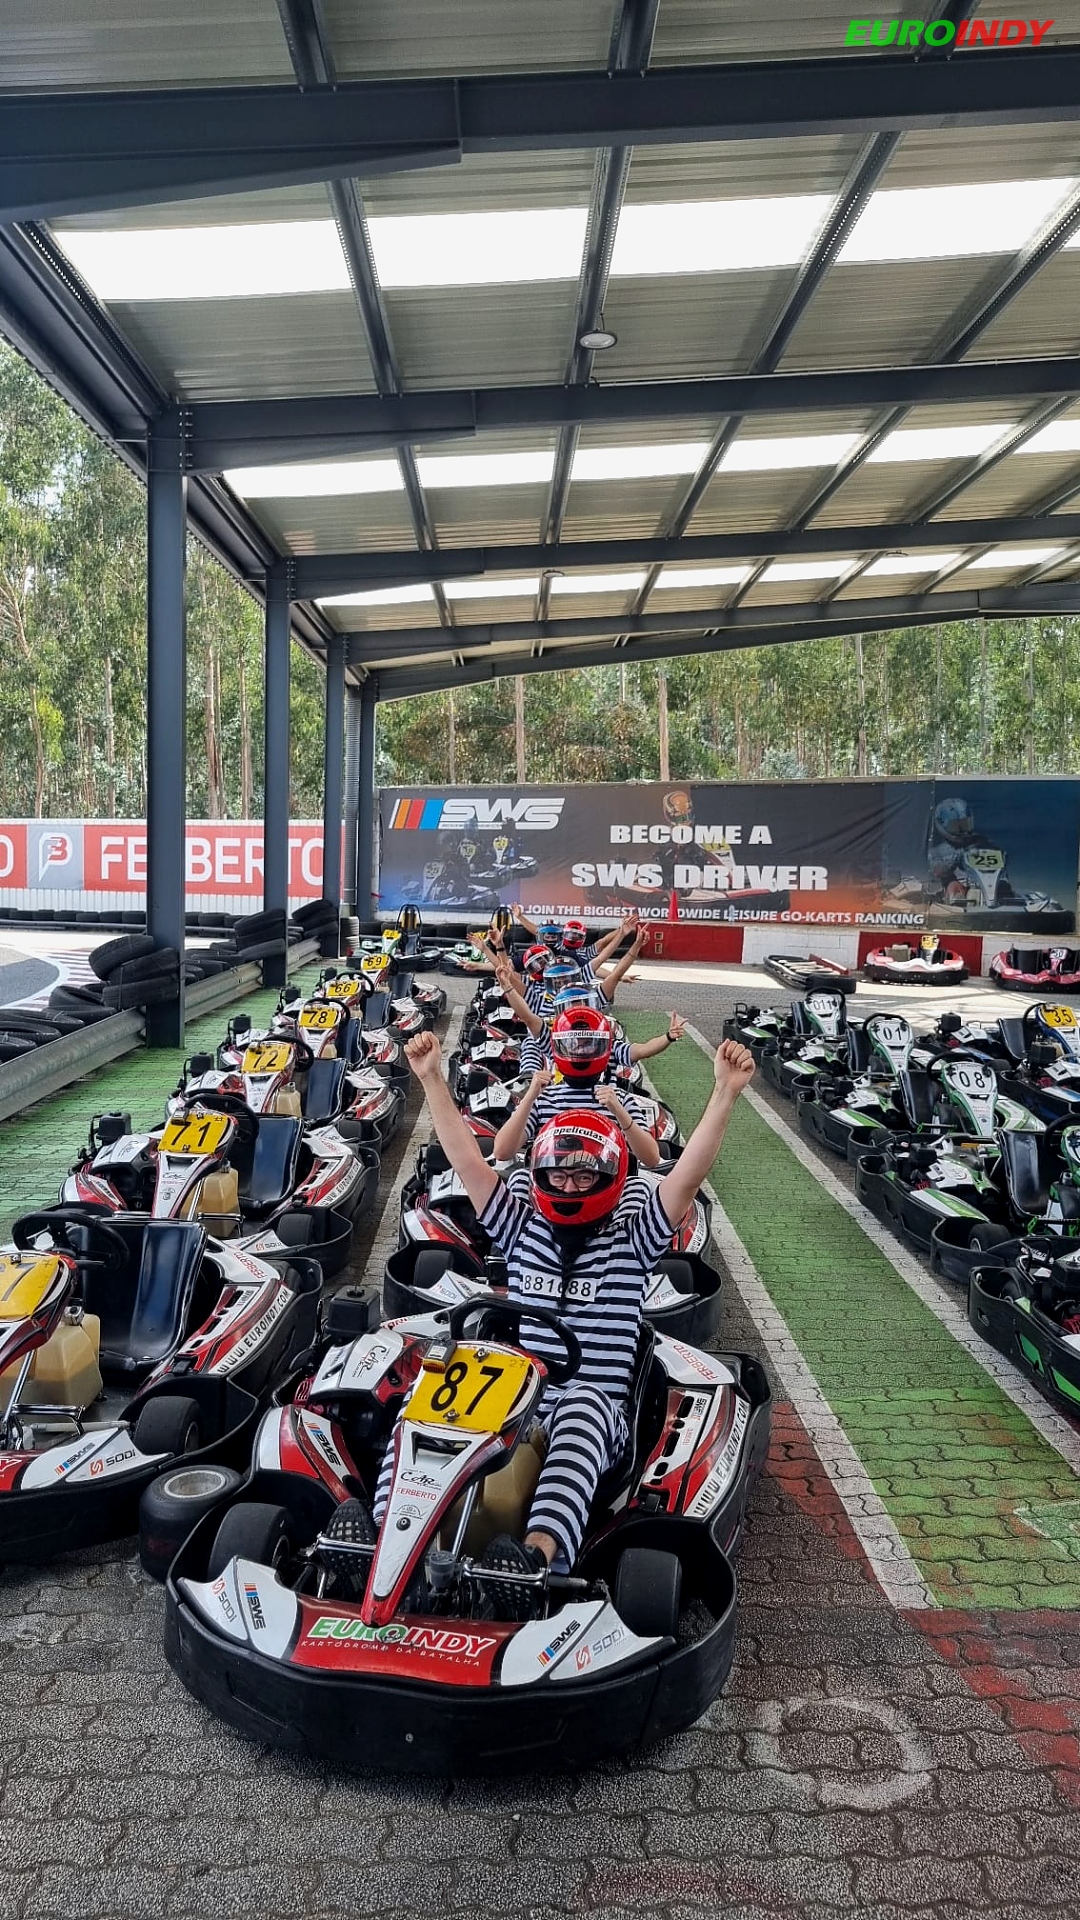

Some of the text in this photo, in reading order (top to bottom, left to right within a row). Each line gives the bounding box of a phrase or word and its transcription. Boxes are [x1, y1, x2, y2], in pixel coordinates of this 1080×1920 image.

[438, 797, 566, 830] SWS
[610, 824, 773, 845] BECOME A
[101, 836, 324, 886] FEBERTO
[571, 863, 829, 891] SWS DRIVER
[525, 904, 555, 915] JOIN
[557, 905, 581, 916] THE
[583, 905, 634, 918] BIGGEST
[638, 906, 721, 919] WORDWIDE
[723, 909, 777, 922] LEISURE
[780, 910, 852, 923] GO-KARTS
[854, 911, 925, 925] RANKING
[303, 1010, 328, 1024] 78
[883, 1026, 902, 1041] 01
[252, 1049, 279, 1068] 72
[959, 1070, 986, 1089] 08
[170, 1120, 212, 1147] 71
[0, 1261, 38, 1302] 7
[217, 1288, 289, 1374] WWW.EUROINDY.COM
[430, 1361, 505, 1416] 87
[105, 1449, 137, 1467] SODI
[693, 1400, 748, 1517] WWW.EUROINDY.COM
[395, 1487, 438, 1501] FERBERTO
[218, 1590, 238, 1623] SODI
[247, 1595, 267, 1631] SWS
[306, 1616, 497, 1659] EUROINDY
[549, 1619, 581, 1653] SWS
[592, 1626, 626, 1657] SODI
[420, 1651, 480, 1667] BATALHA
